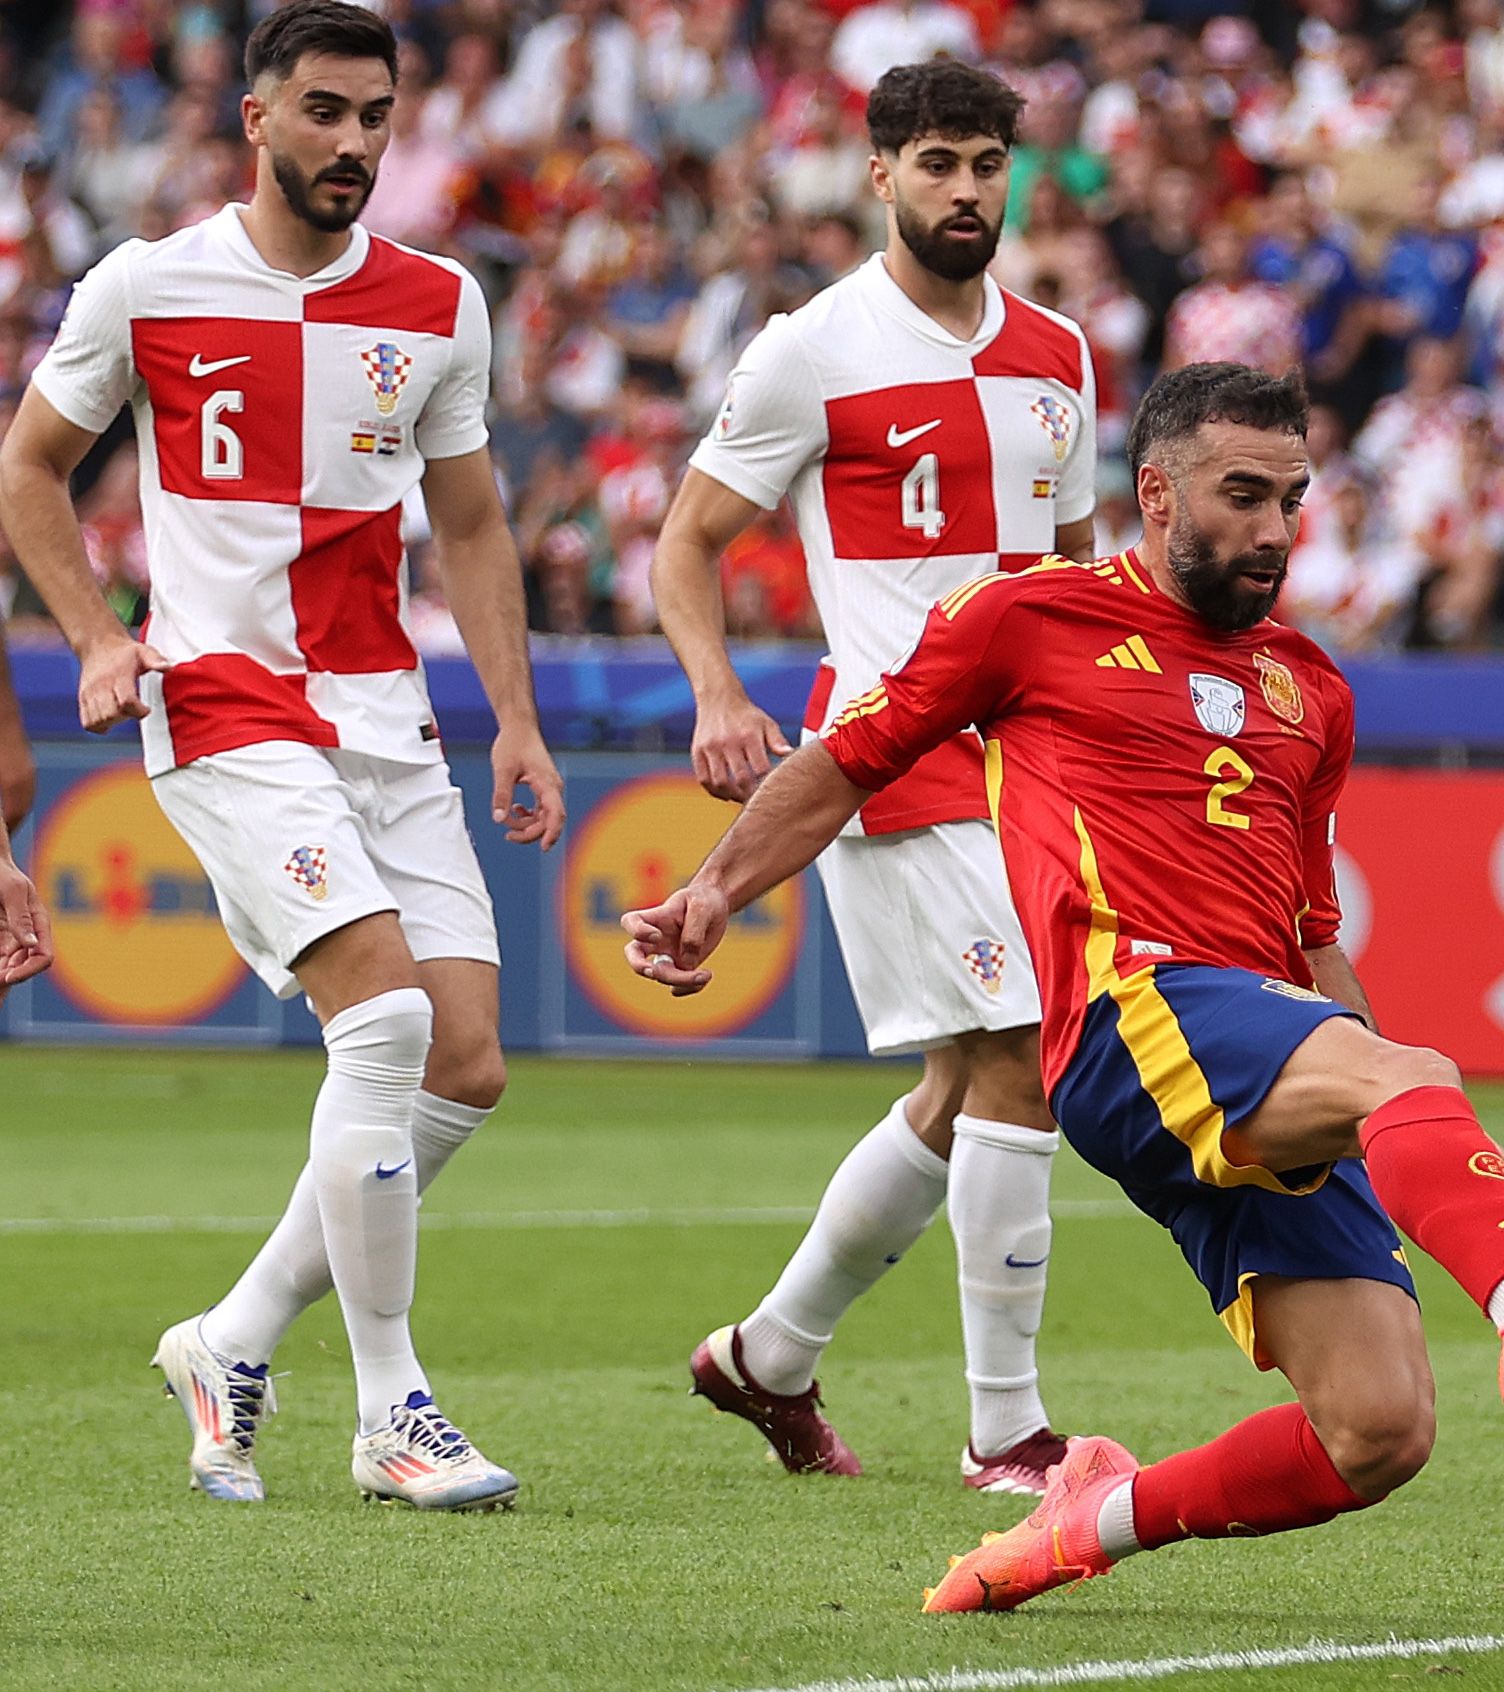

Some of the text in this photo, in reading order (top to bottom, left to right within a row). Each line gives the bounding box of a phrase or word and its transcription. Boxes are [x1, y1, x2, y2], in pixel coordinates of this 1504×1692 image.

[201, 390, 243, 480] 6
[901, 452, 946, 540] 4
[1203, 745, 1256, 830] 2
